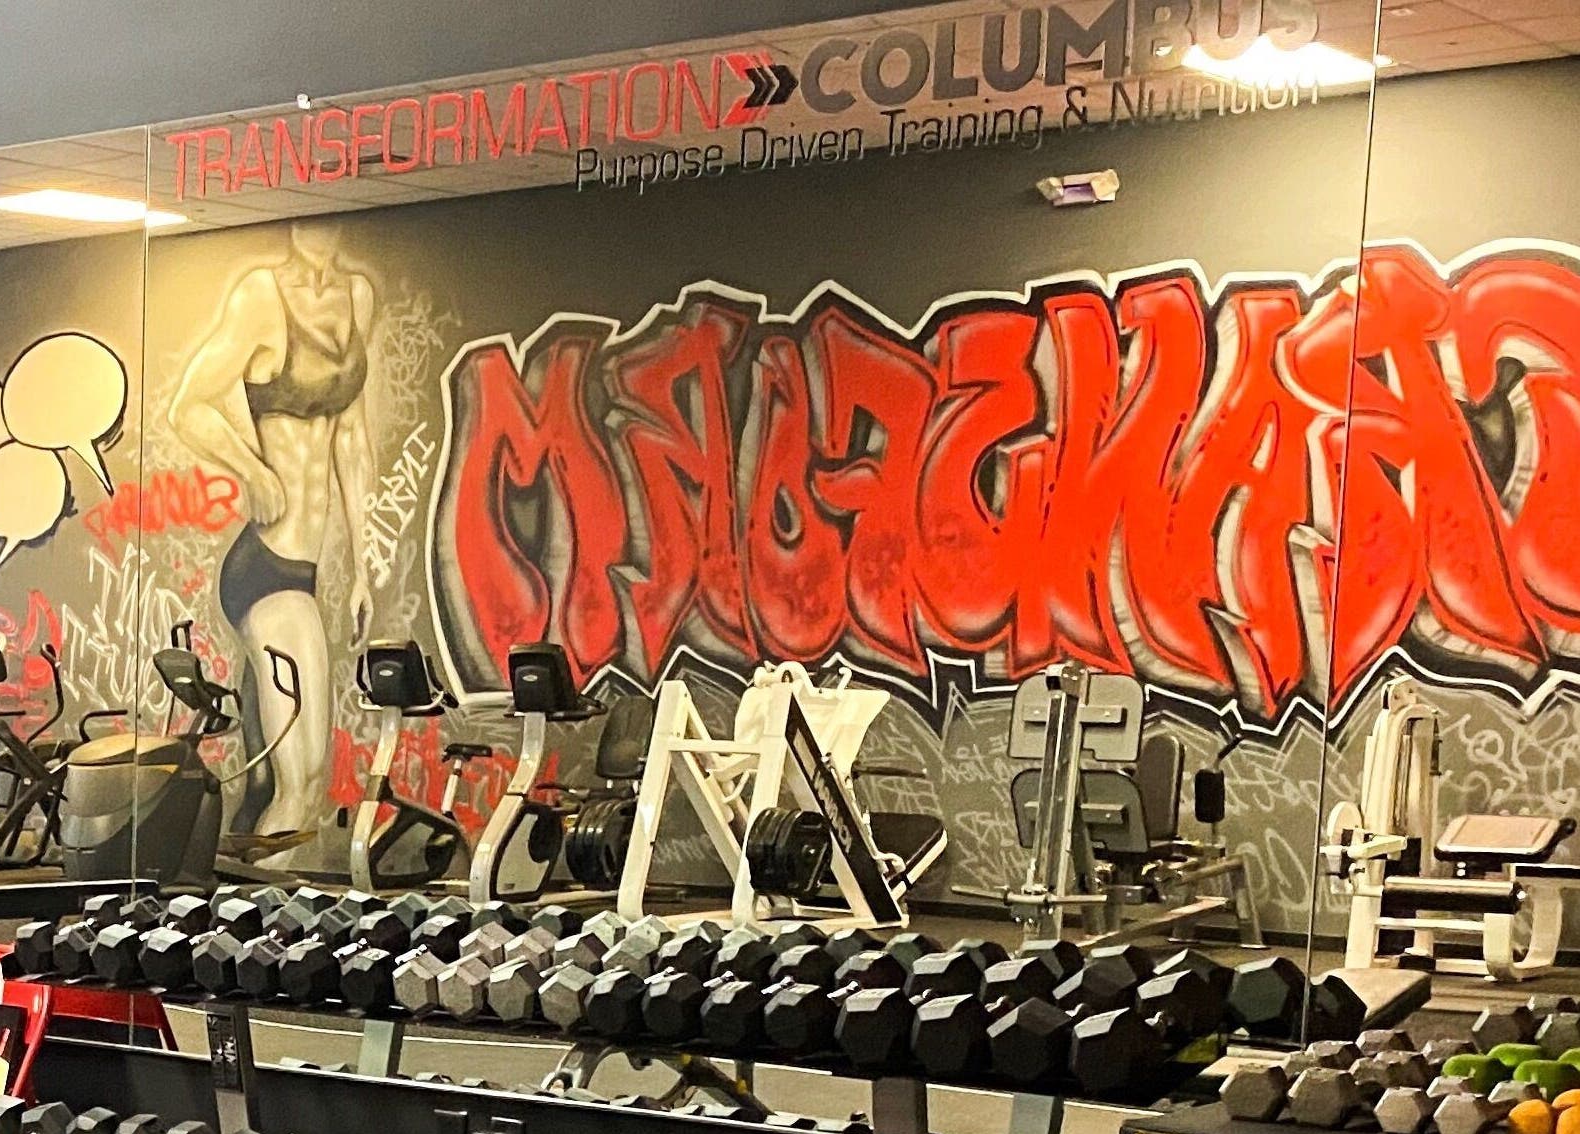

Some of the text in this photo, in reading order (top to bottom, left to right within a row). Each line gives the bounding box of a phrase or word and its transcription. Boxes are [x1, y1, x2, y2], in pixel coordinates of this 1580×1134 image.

[166, 0, 1319, 203] TRANSFORMATION COLUMBUS
[576, 70, 1319, 195] Purpose Driven Training & Nutrition
